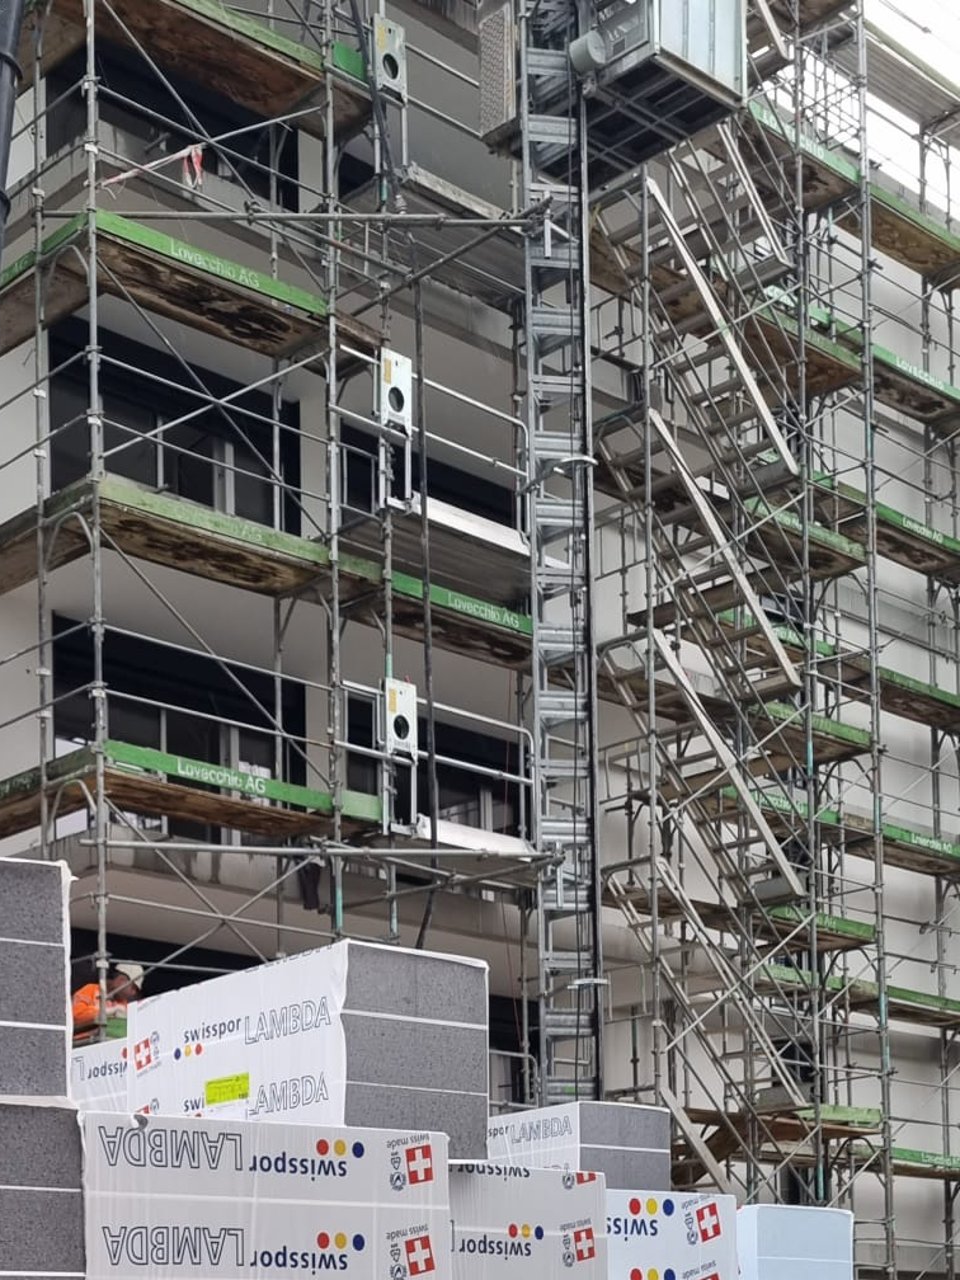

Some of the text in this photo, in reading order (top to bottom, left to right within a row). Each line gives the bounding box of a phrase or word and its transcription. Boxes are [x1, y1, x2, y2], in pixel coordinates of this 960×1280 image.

[170, 238, 260, 289] Lovecchio AG
[448, 592, 520, 628] Lovecchio AG
[177, 759, 267, 795] Lovecchio AG
[183, 996, 331, 1045] swisspor LAMBDA
[98, 1126, 347, 1182] swisspor LAMBDA
[386, 1132, 430, 1149] swiss made
[386, 1223, 429, 1241] swiss made
[459, 1235, 532, 1260] swisspor
[102, 1226, 348, 1276] swisspor LAMBDA
